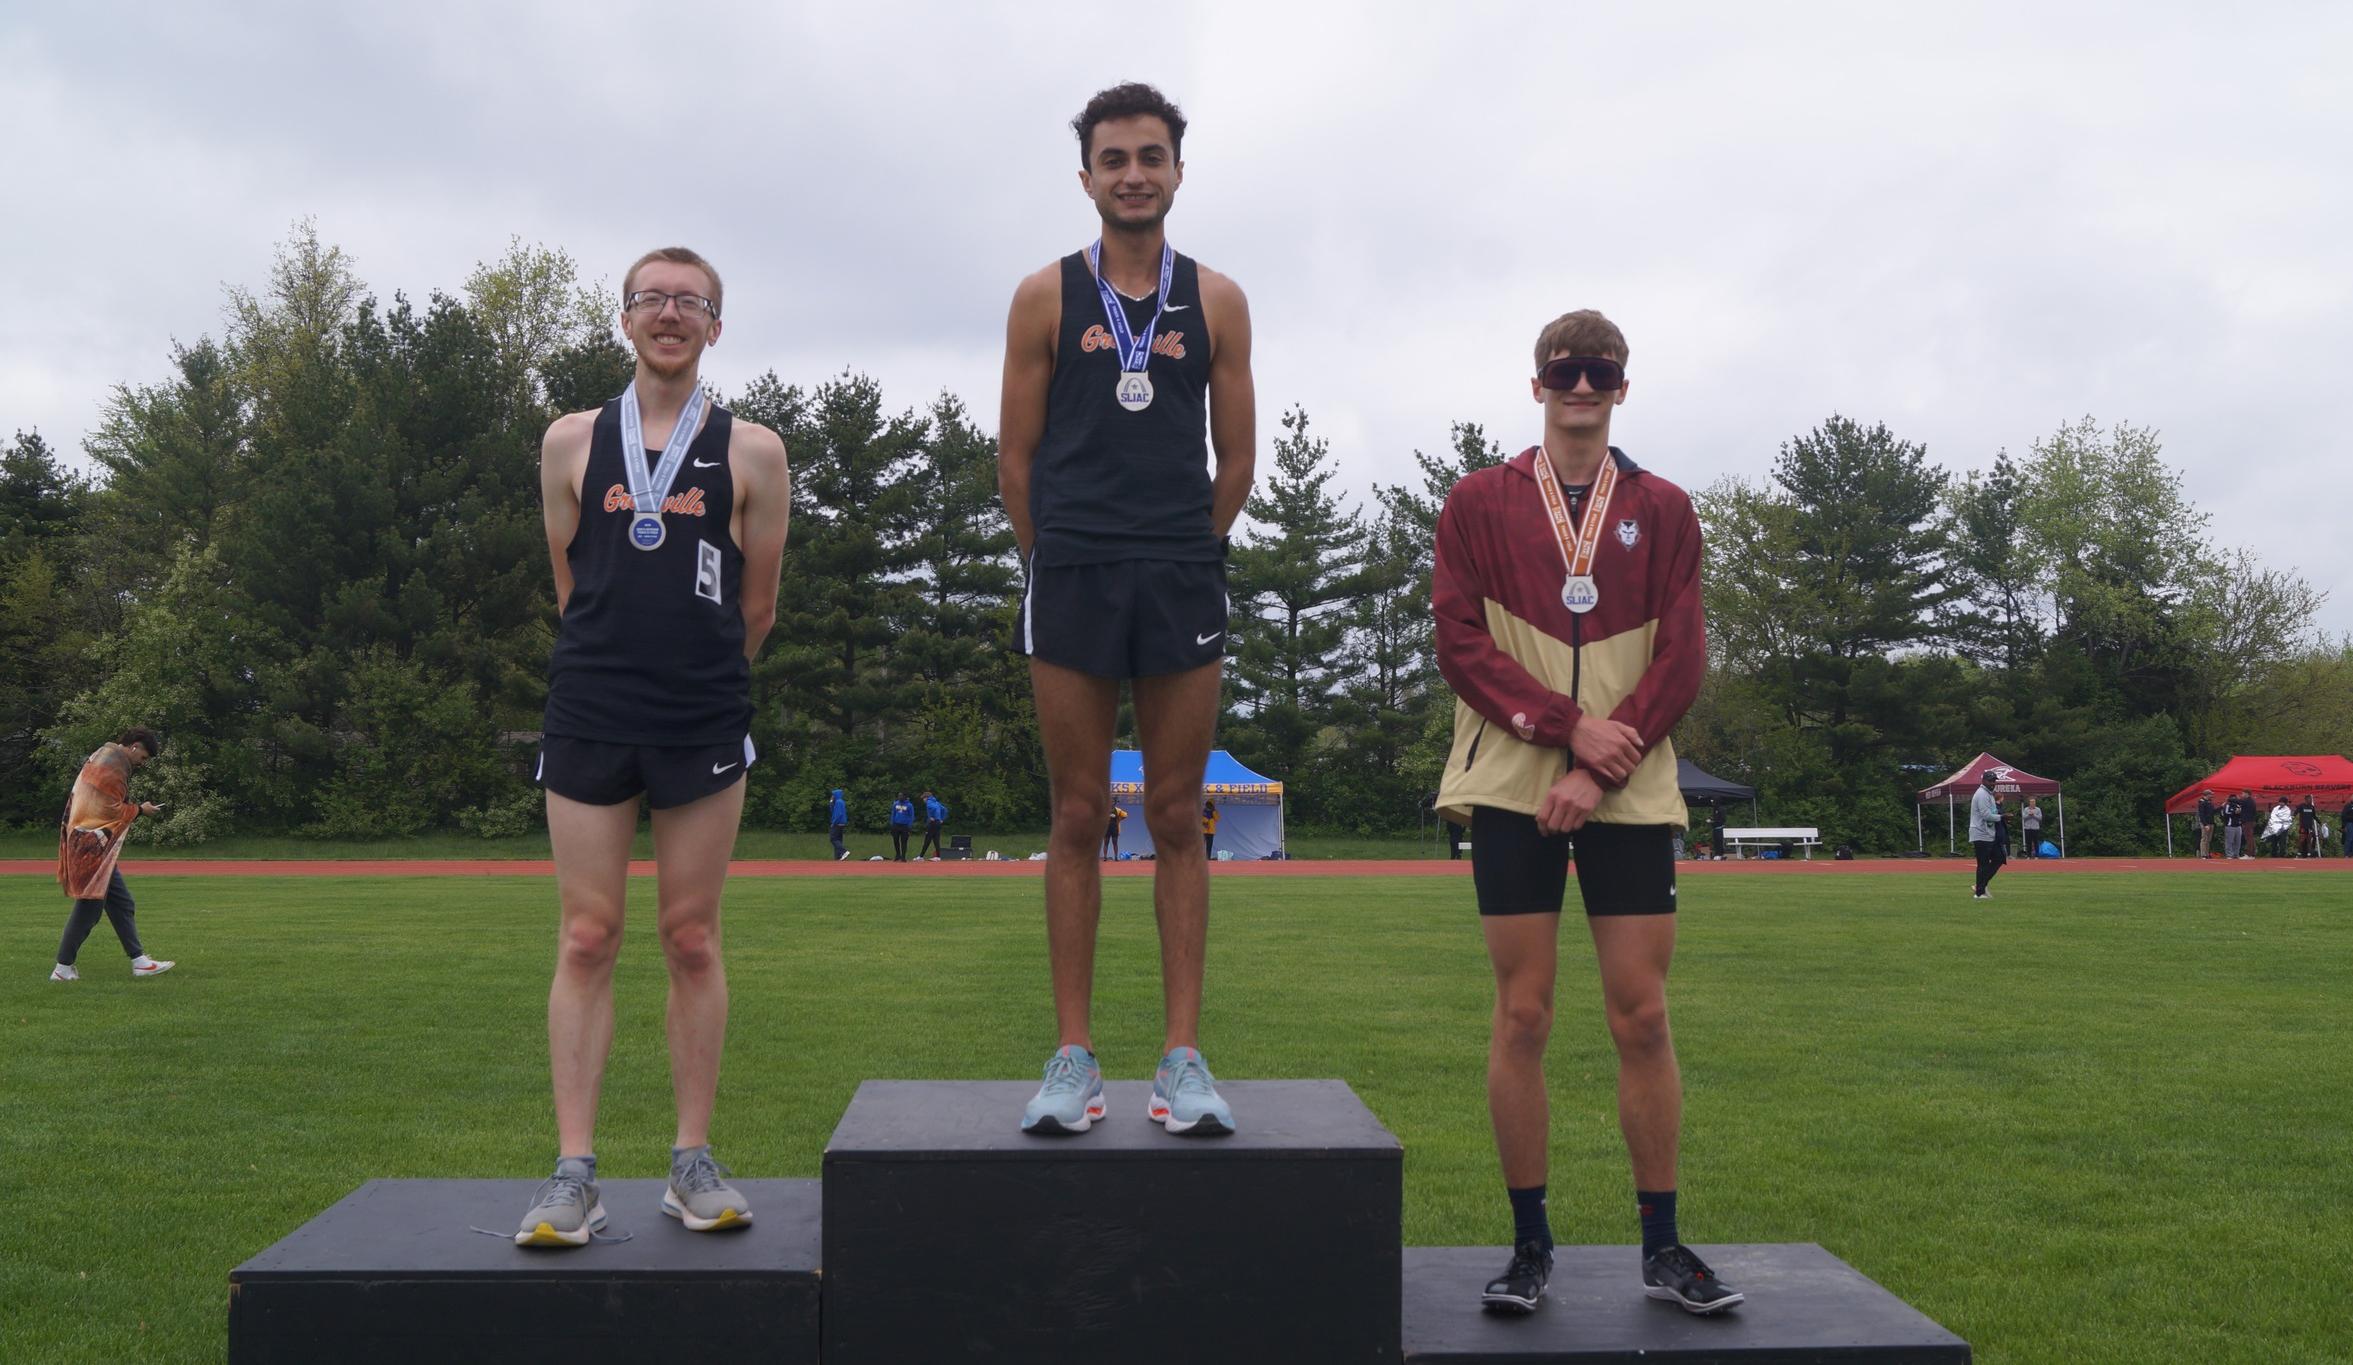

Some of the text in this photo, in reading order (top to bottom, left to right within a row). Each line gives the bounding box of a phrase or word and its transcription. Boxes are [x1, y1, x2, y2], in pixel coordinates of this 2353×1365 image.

[1120, 392, 1150, 403] SLIAC
[698, 544, 718, 598] 5
[1566, 595, 1594, 605] SLIAC
[1229, 784, 1267, 793] FIELD
[1994, 784, 2021, 793] UREKA
